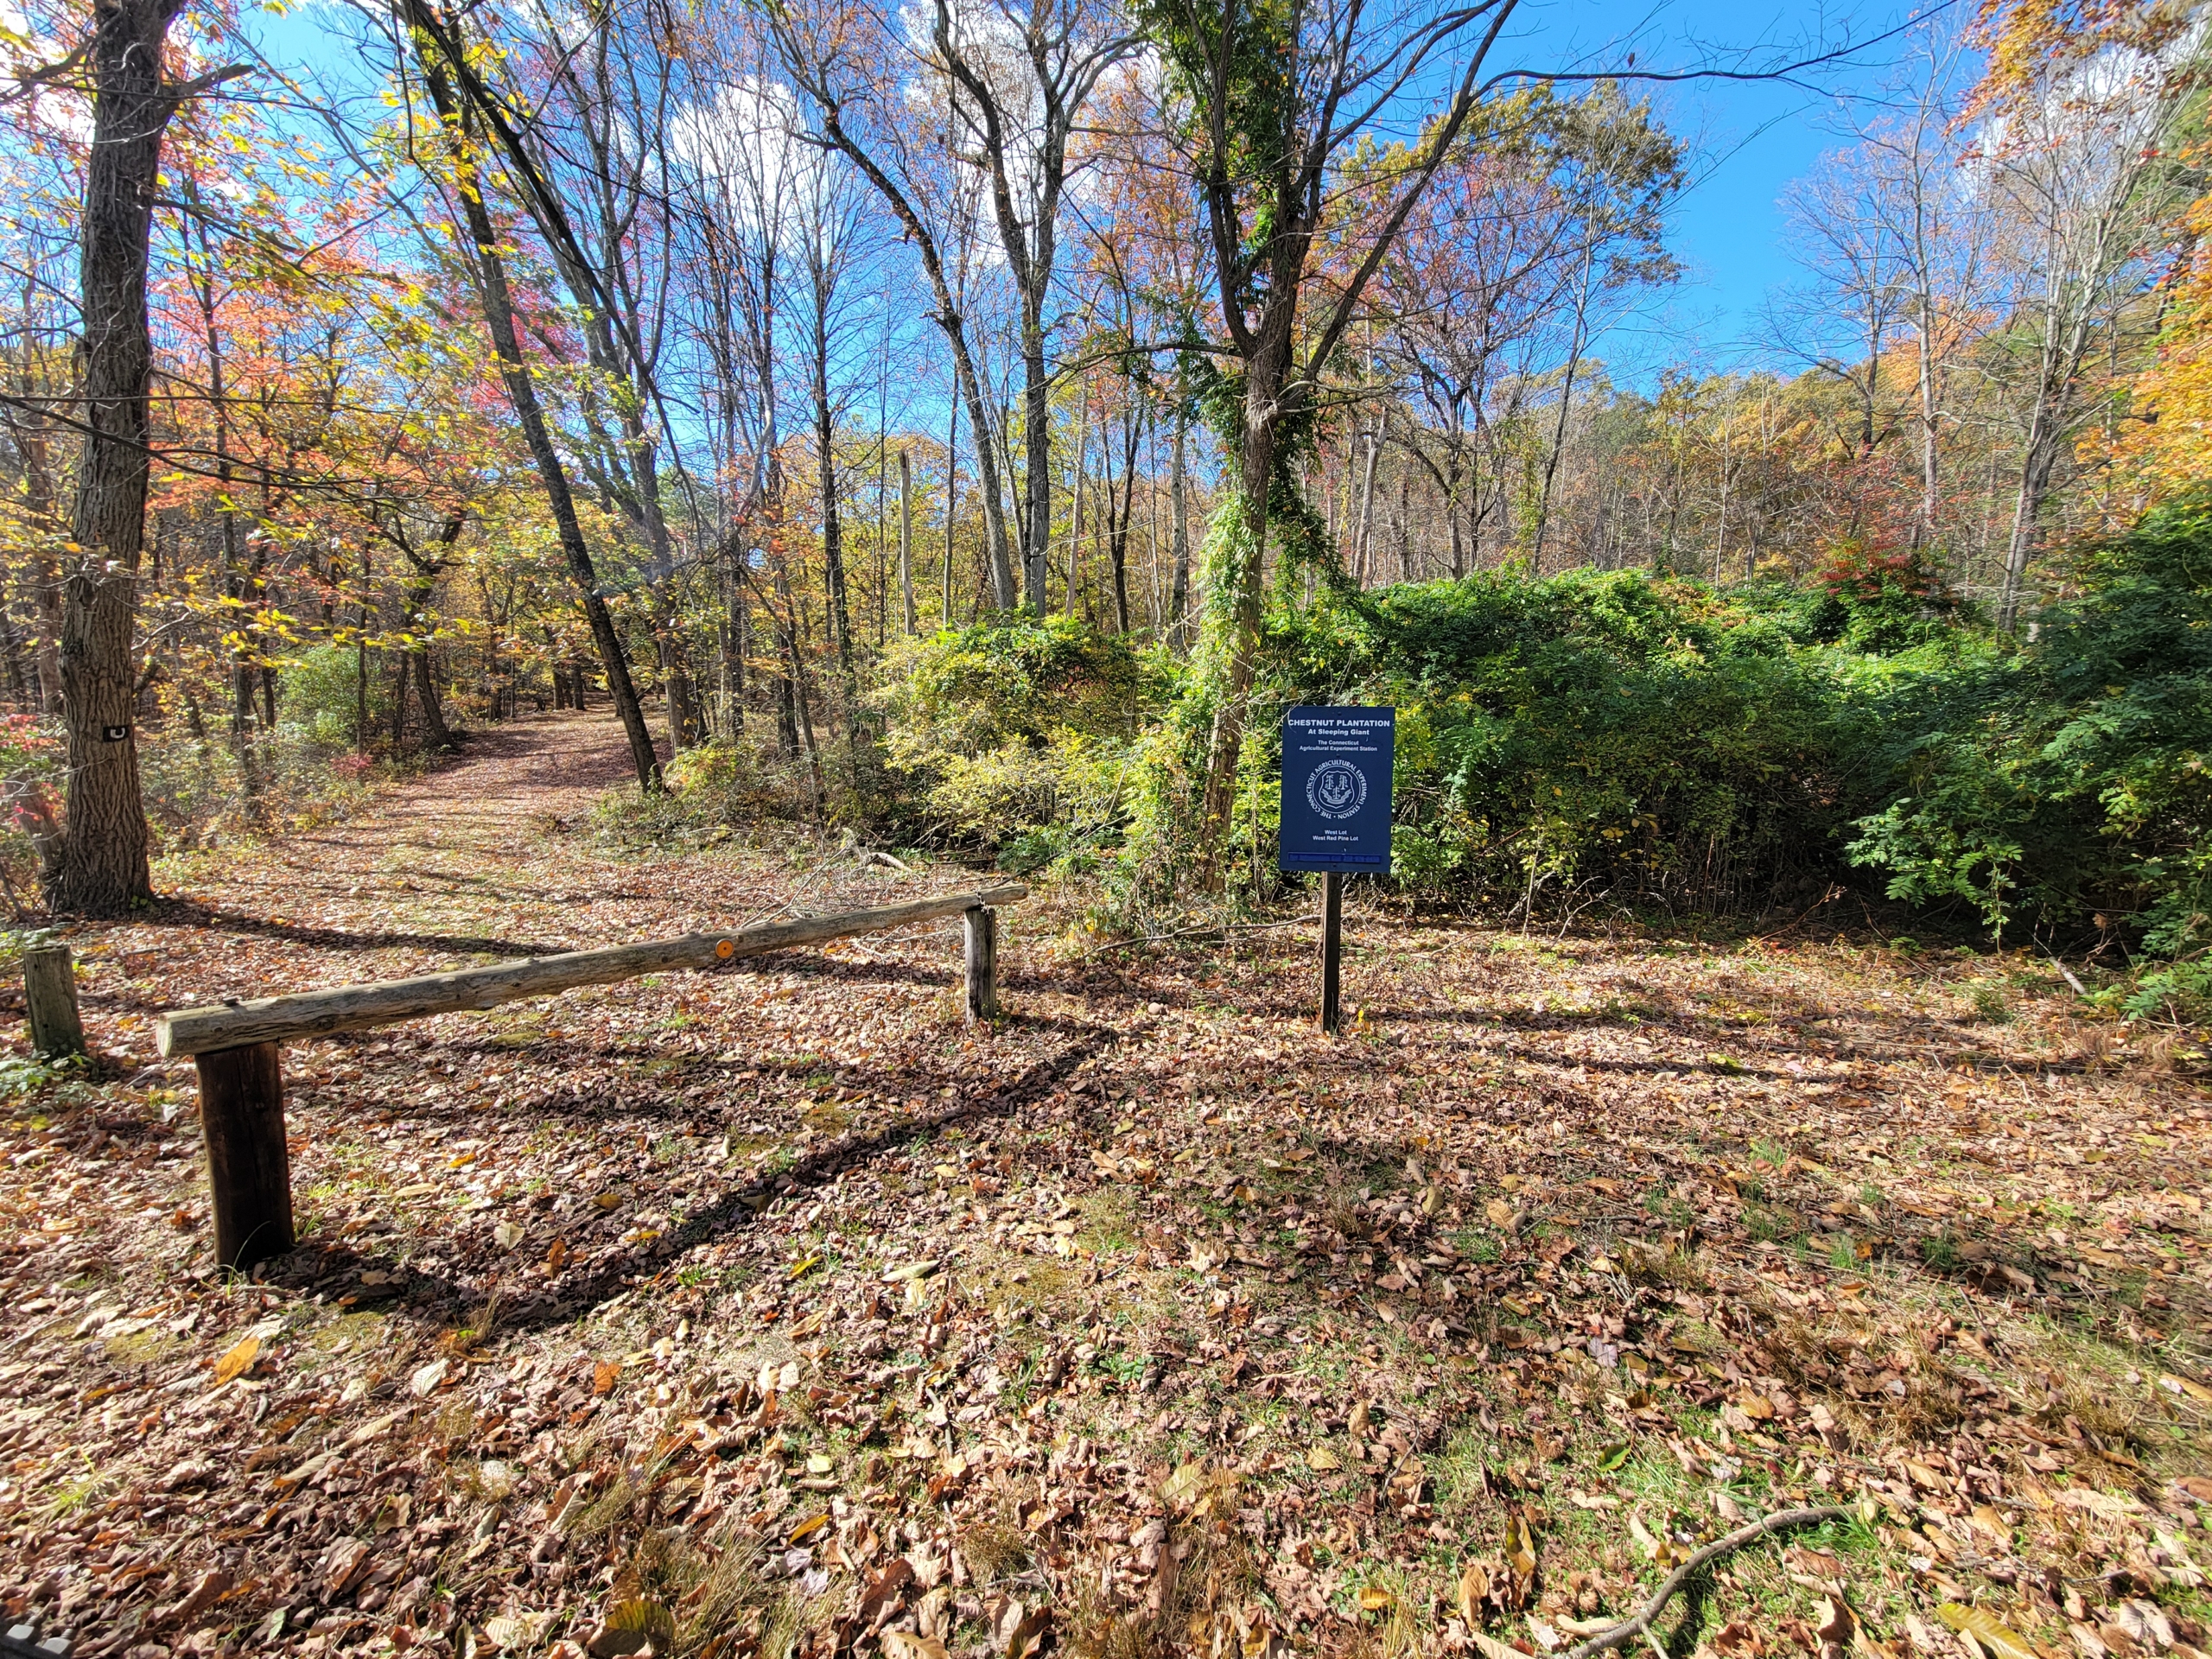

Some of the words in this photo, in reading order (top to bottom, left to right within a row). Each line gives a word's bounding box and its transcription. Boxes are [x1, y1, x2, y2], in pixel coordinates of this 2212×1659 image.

[1314, 759, 1357, 773] AGRICULTURAL
[1306, 772, 1320, 812] CONNECTICUT
[1356, 769, 1367, 804] EXPERIMENT
[1320, 810, 1332, 819] THE
[1338, 804, 1361, 819] STATION
